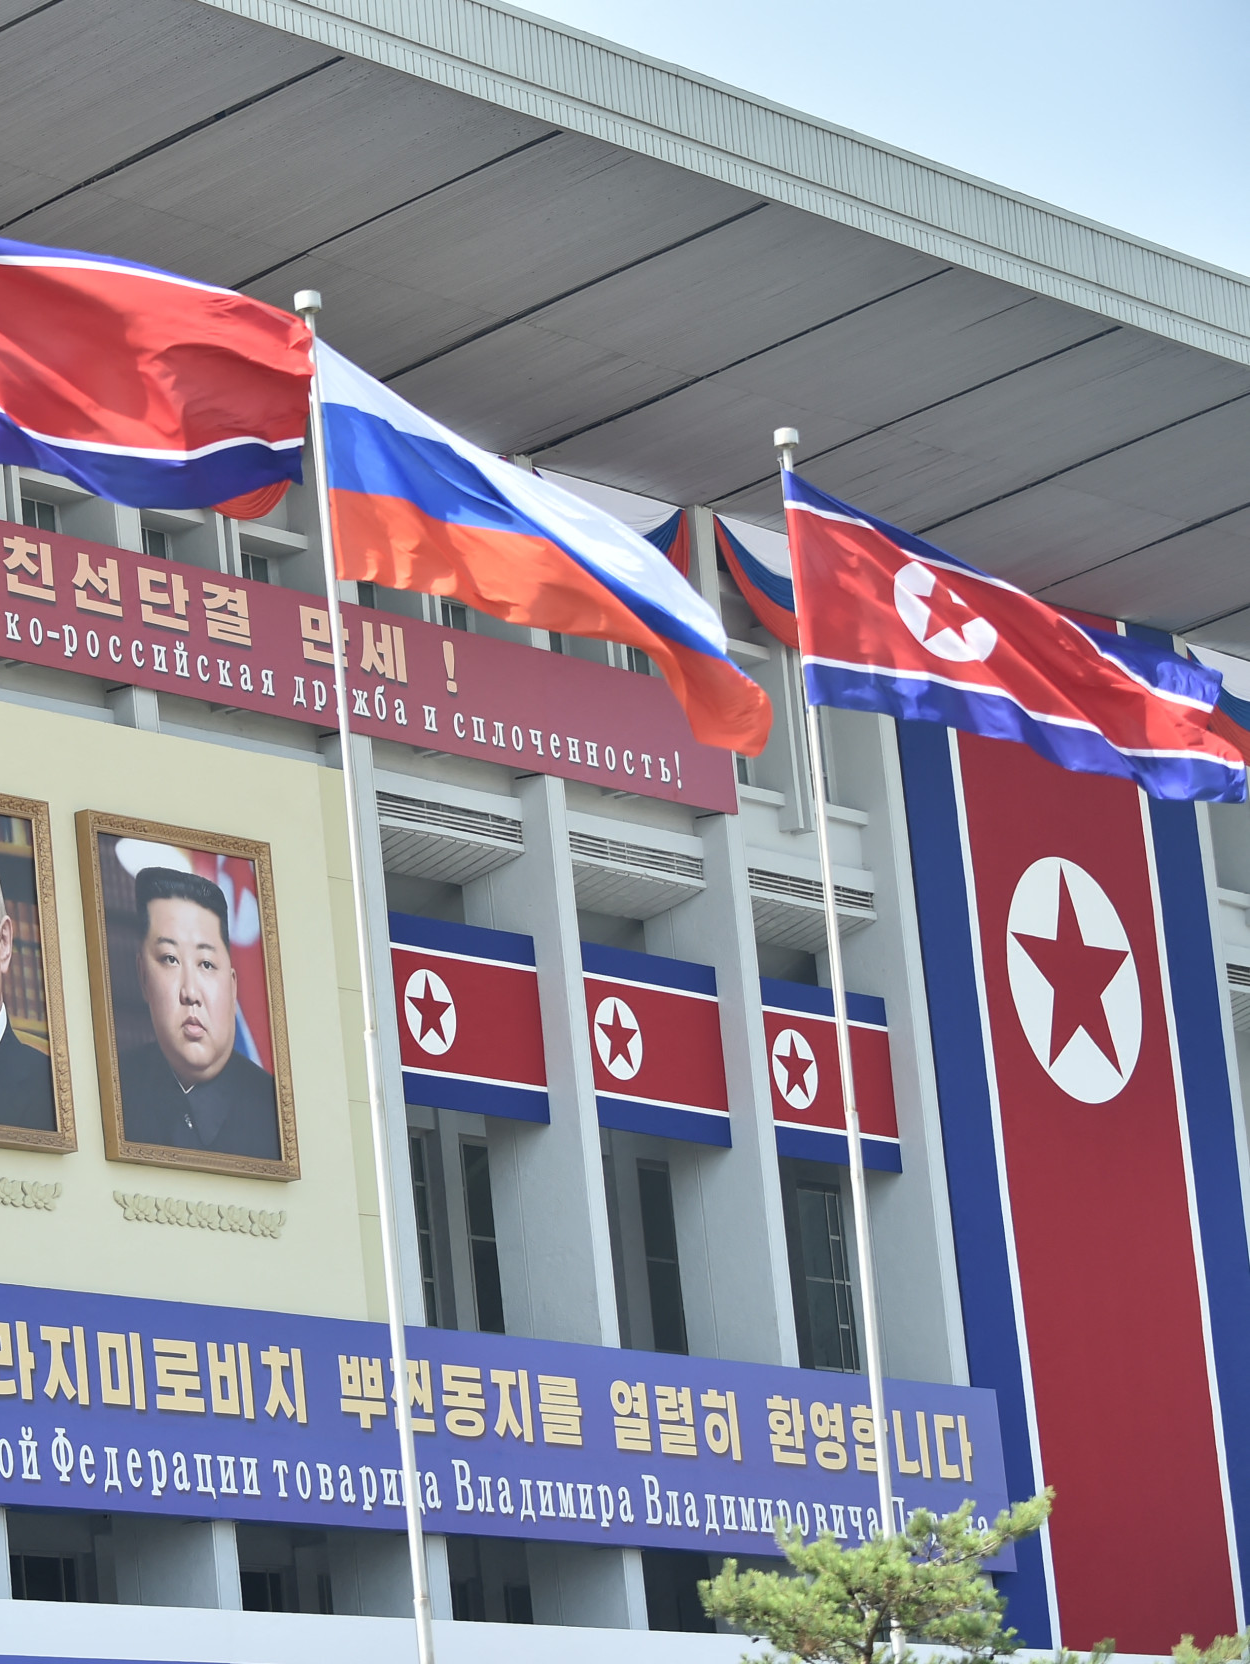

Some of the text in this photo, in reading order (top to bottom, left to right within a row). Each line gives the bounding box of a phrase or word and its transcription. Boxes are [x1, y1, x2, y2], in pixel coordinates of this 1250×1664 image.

[299, 605, 408, 684] 만세
[293, 676, 408, 726] држба
[422, 704, 439, 732] и
[453, 712, 683, 791] сплоченность!
[338, 1354, 583, 1446] 뿌찐동지를
[610, 1379, 742, 1461] 열렬히
[766, 1394, 973, 1482] 환영합니다
[51, 1427, 261, 1500] Федерации
[451, 1459, 635, 1528] Владимира
[640, 1474, 880, 1542] Владимировича
